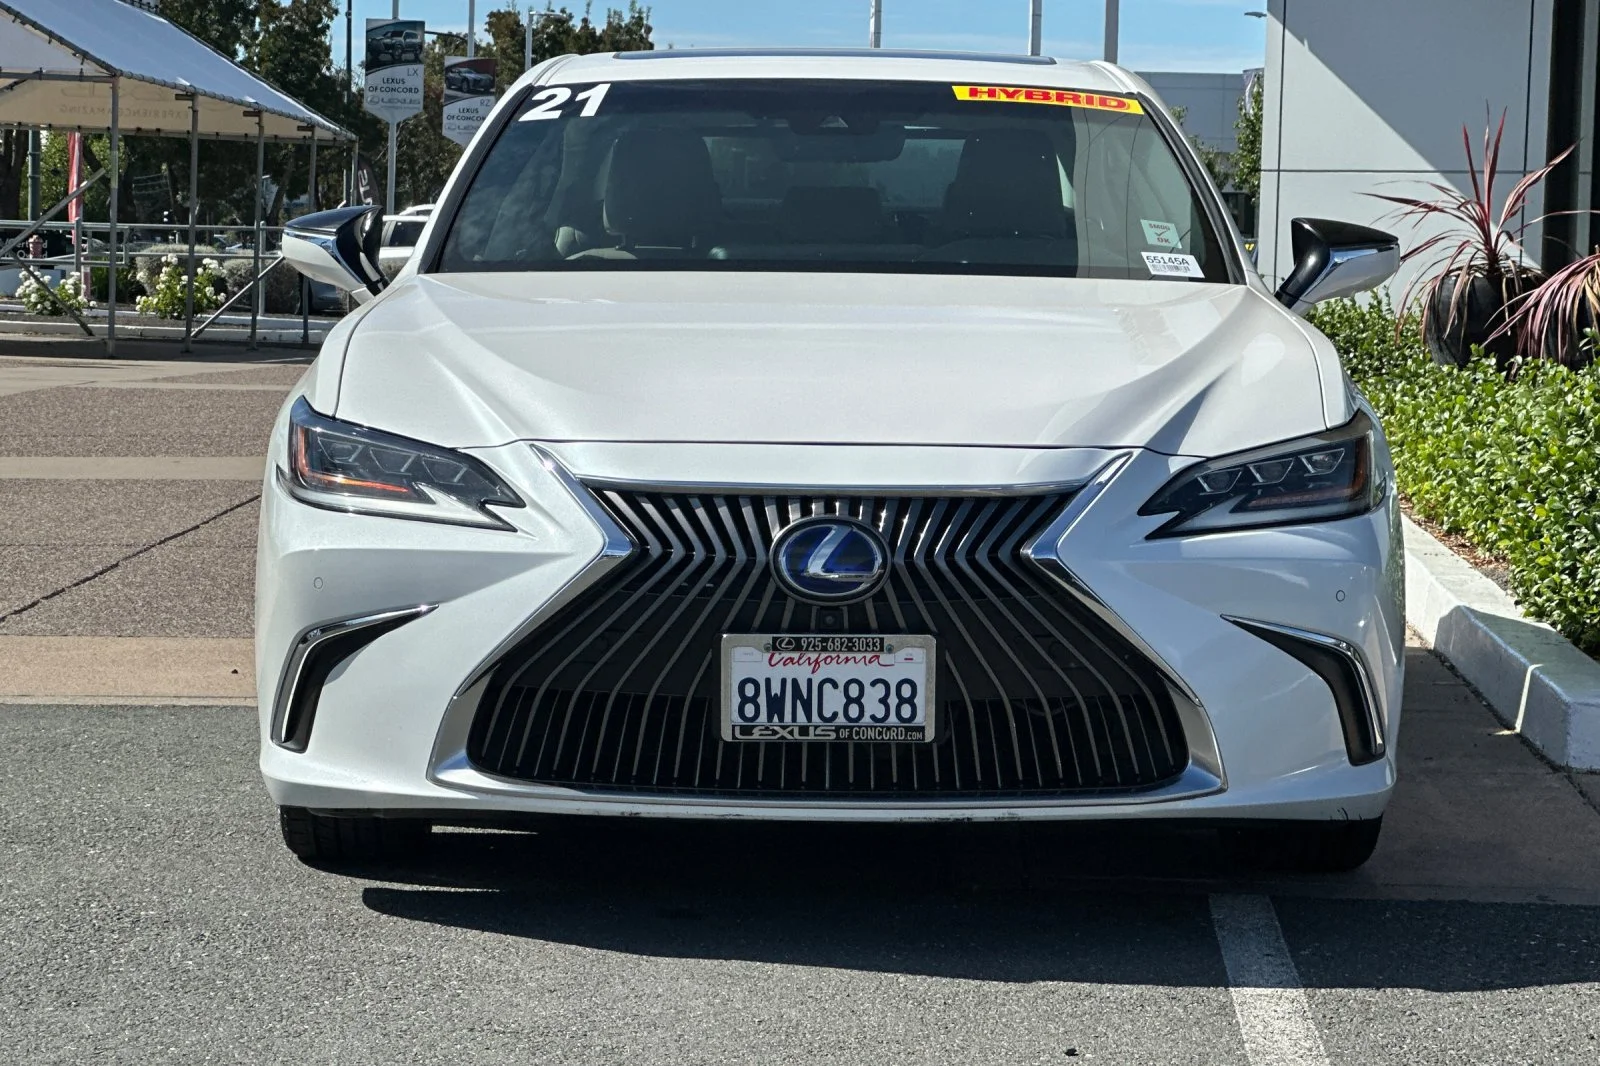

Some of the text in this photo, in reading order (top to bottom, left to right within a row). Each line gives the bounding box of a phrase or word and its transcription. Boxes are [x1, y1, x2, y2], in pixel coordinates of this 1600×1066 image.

[407, 67, 419, 76] LX
[380, 86, 419, 94] CONCORD
[518, 83, 611, 121] 21
[968, 87, 1130, 110] HYBRID
[1146, 255, 1190, 266] 55145A
[801, 637, 880, 651] 925-682-3033
[768, 652, 895, 674] California
[737, 677, 918, 724] 8WNC838
[734, 725, 836, 740] LEXUS
[839, 728, 850, 739] OF
